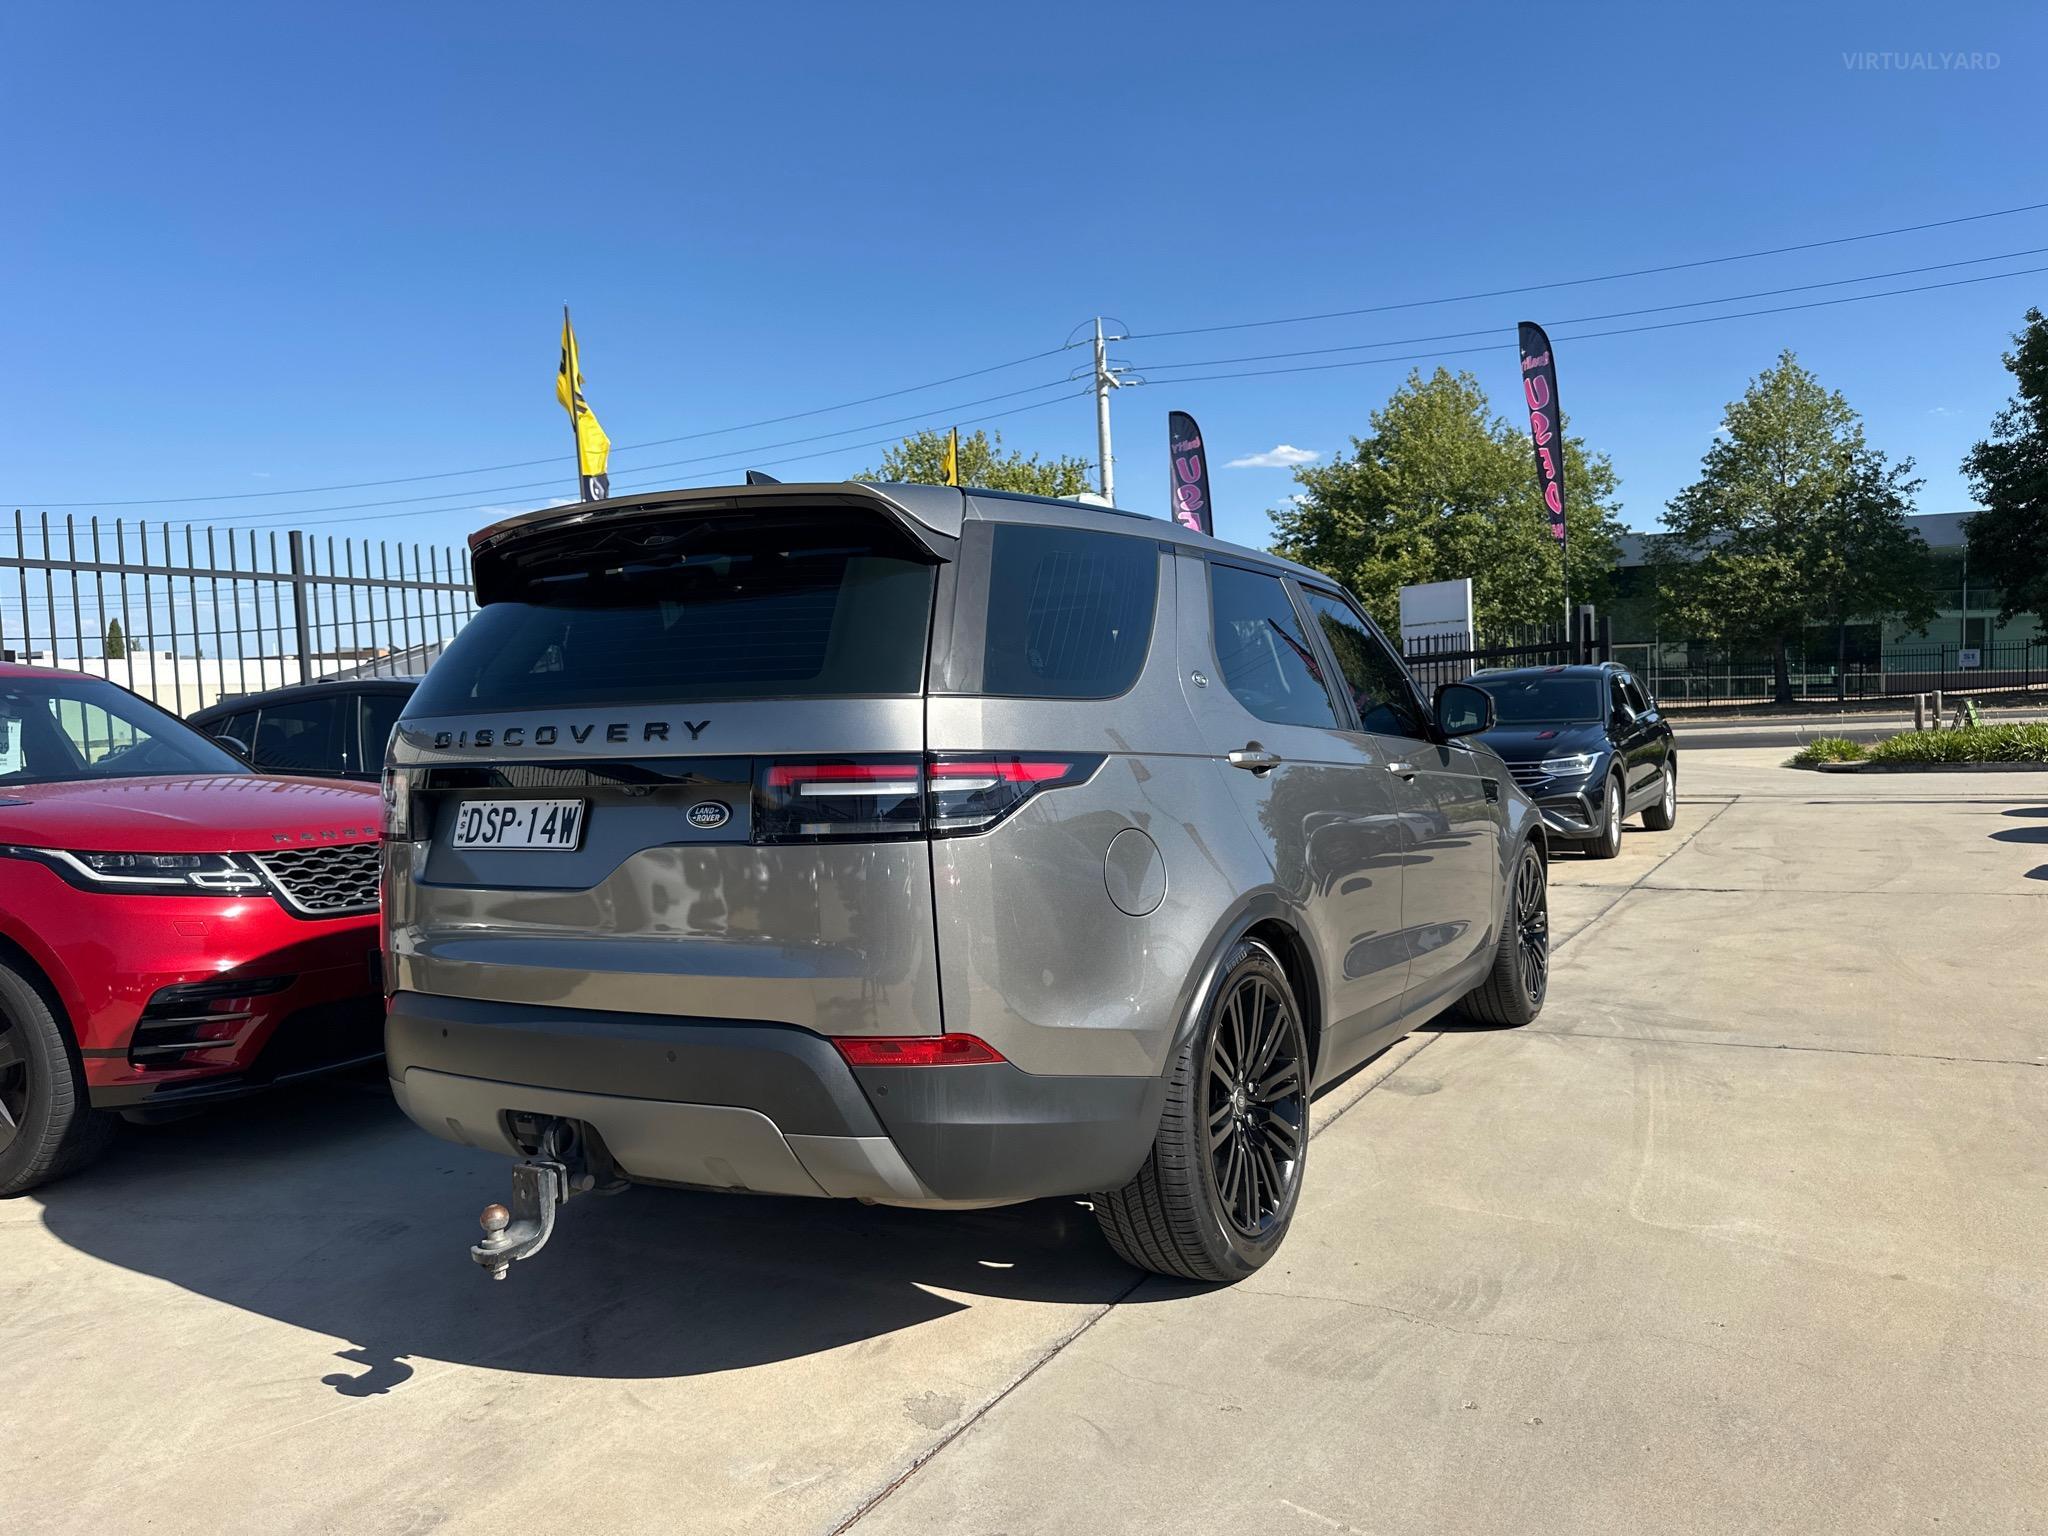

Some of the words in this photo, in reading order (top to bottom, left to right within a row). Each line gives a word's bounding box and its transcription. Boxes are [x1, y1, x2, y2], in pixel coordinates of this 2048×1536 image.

[433, 719, 712, 750] DISCOVERY
[694, 806, 715, 815] LAND
[695, 814, 721, 822] ROVER
